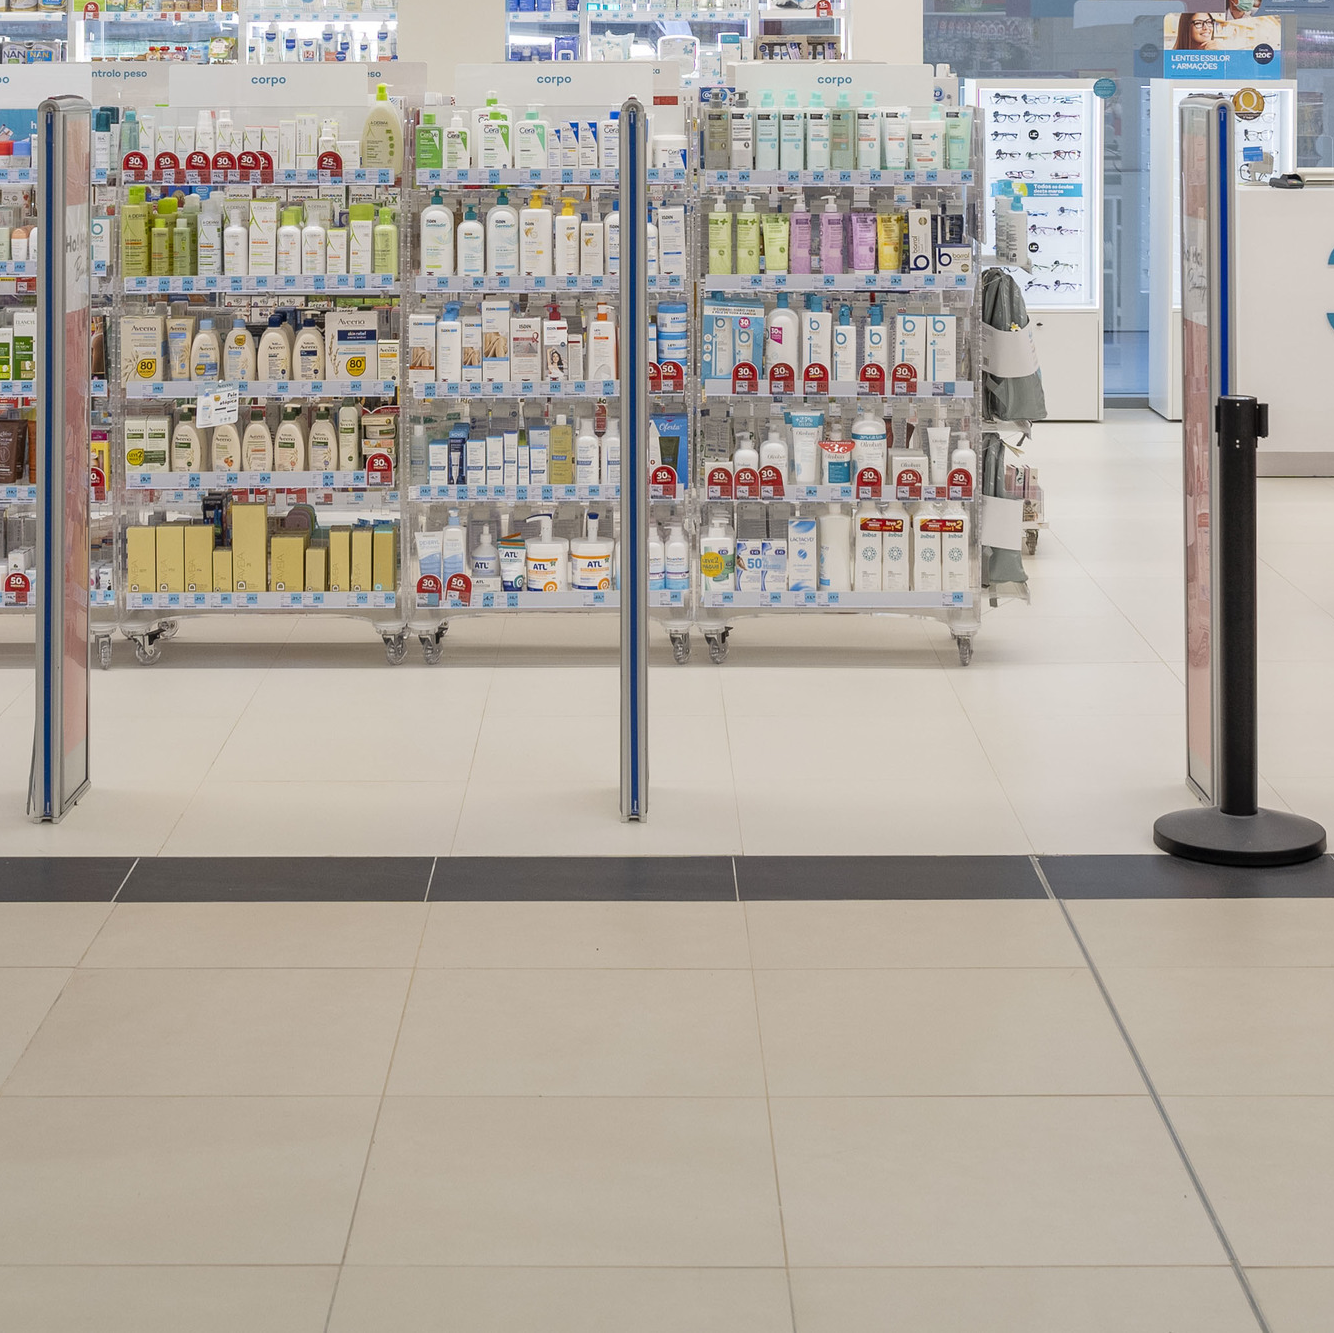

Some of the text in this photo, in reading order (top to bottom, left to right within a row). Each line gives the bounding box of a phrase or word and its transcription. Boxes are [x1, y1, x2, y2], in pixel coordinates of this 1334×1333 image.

[4, 50, 26, 59] NAN
[1171, 54, 1230, 62] LENTES ESSILOR
[1177, 62, 1218, 71] ARMAÇÕES
[90, 69, 148, 80] ntrolo peso
[251, 75, 287, 87] corpo
[536, 75, 572, 86] corpo
[817, 75, 853, 86] corpo
